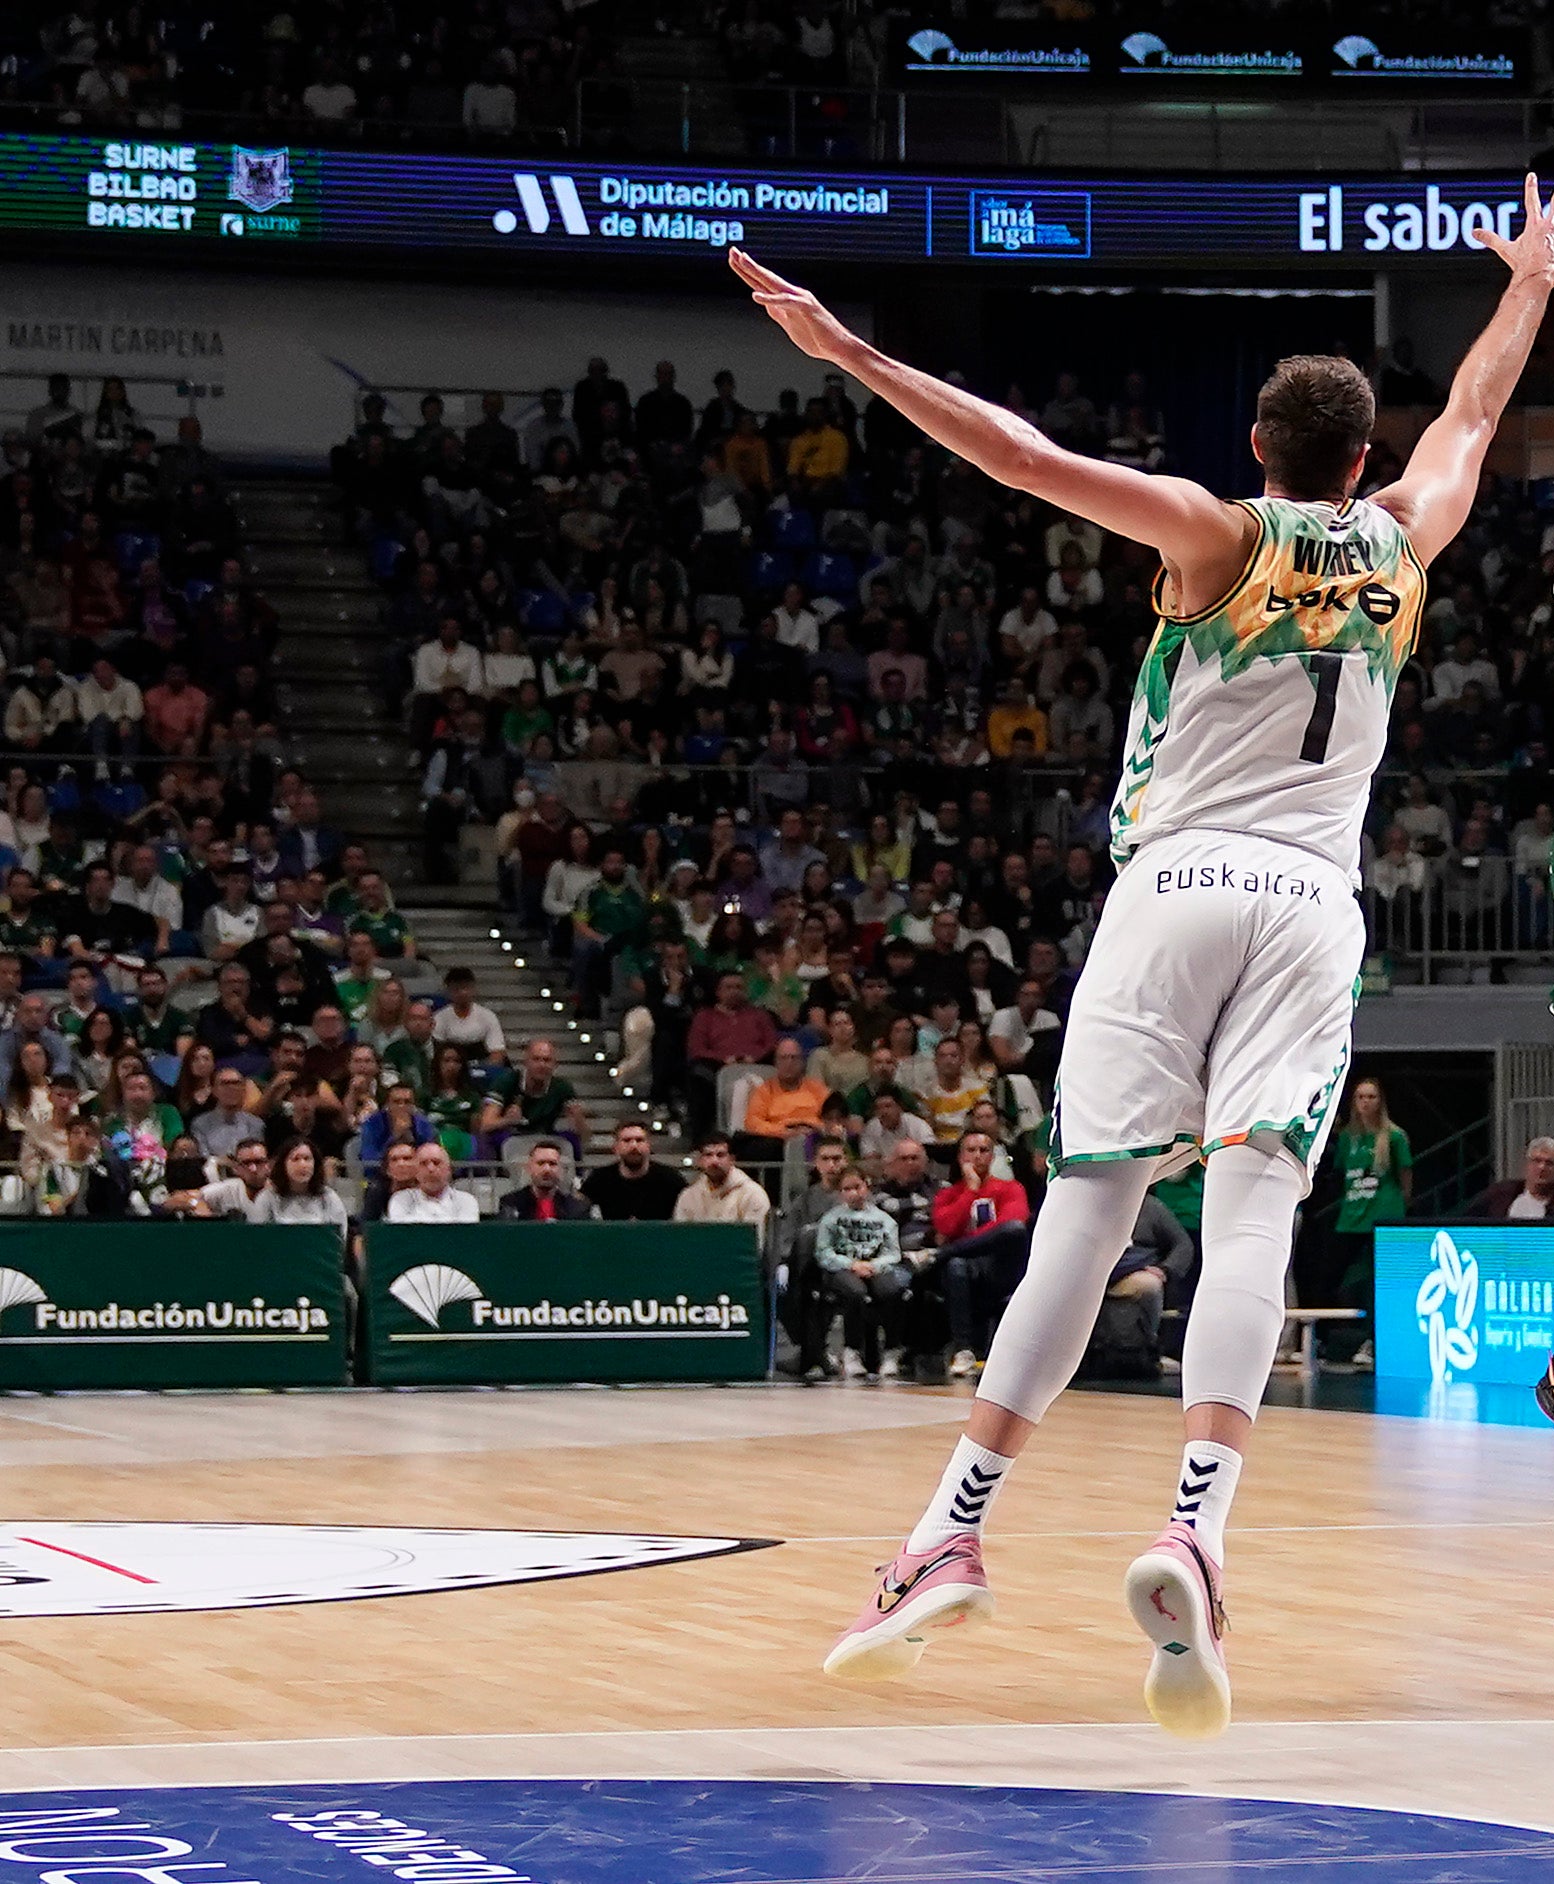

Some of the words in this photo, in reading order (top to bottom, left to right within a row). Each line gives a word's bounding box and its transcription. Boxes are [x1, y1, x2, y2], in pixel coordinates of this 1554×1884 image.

[104, 143, 197, 172] SURNE
[87, 171, 197, 200] BILBAO
[600, 177, 750, 210] Diputación
[755, 182, 889, 215] Provincial
[87, 201, 196, 230] BASKET
[600, 211, 637, 238] de
[642, 214, 744, 247] Málaga
[1299, 185, 1343, 251] El
[1363, 184, 1520, 251] sabor
[981, 219, 1036, 250] laga
[1484, 1271, 1553, 1313] MÁLAGA
[36, 1296, 330, 1334] FundaciónUnicaja
[471, 1294, 750, 1330] FundaciónUnicaja
